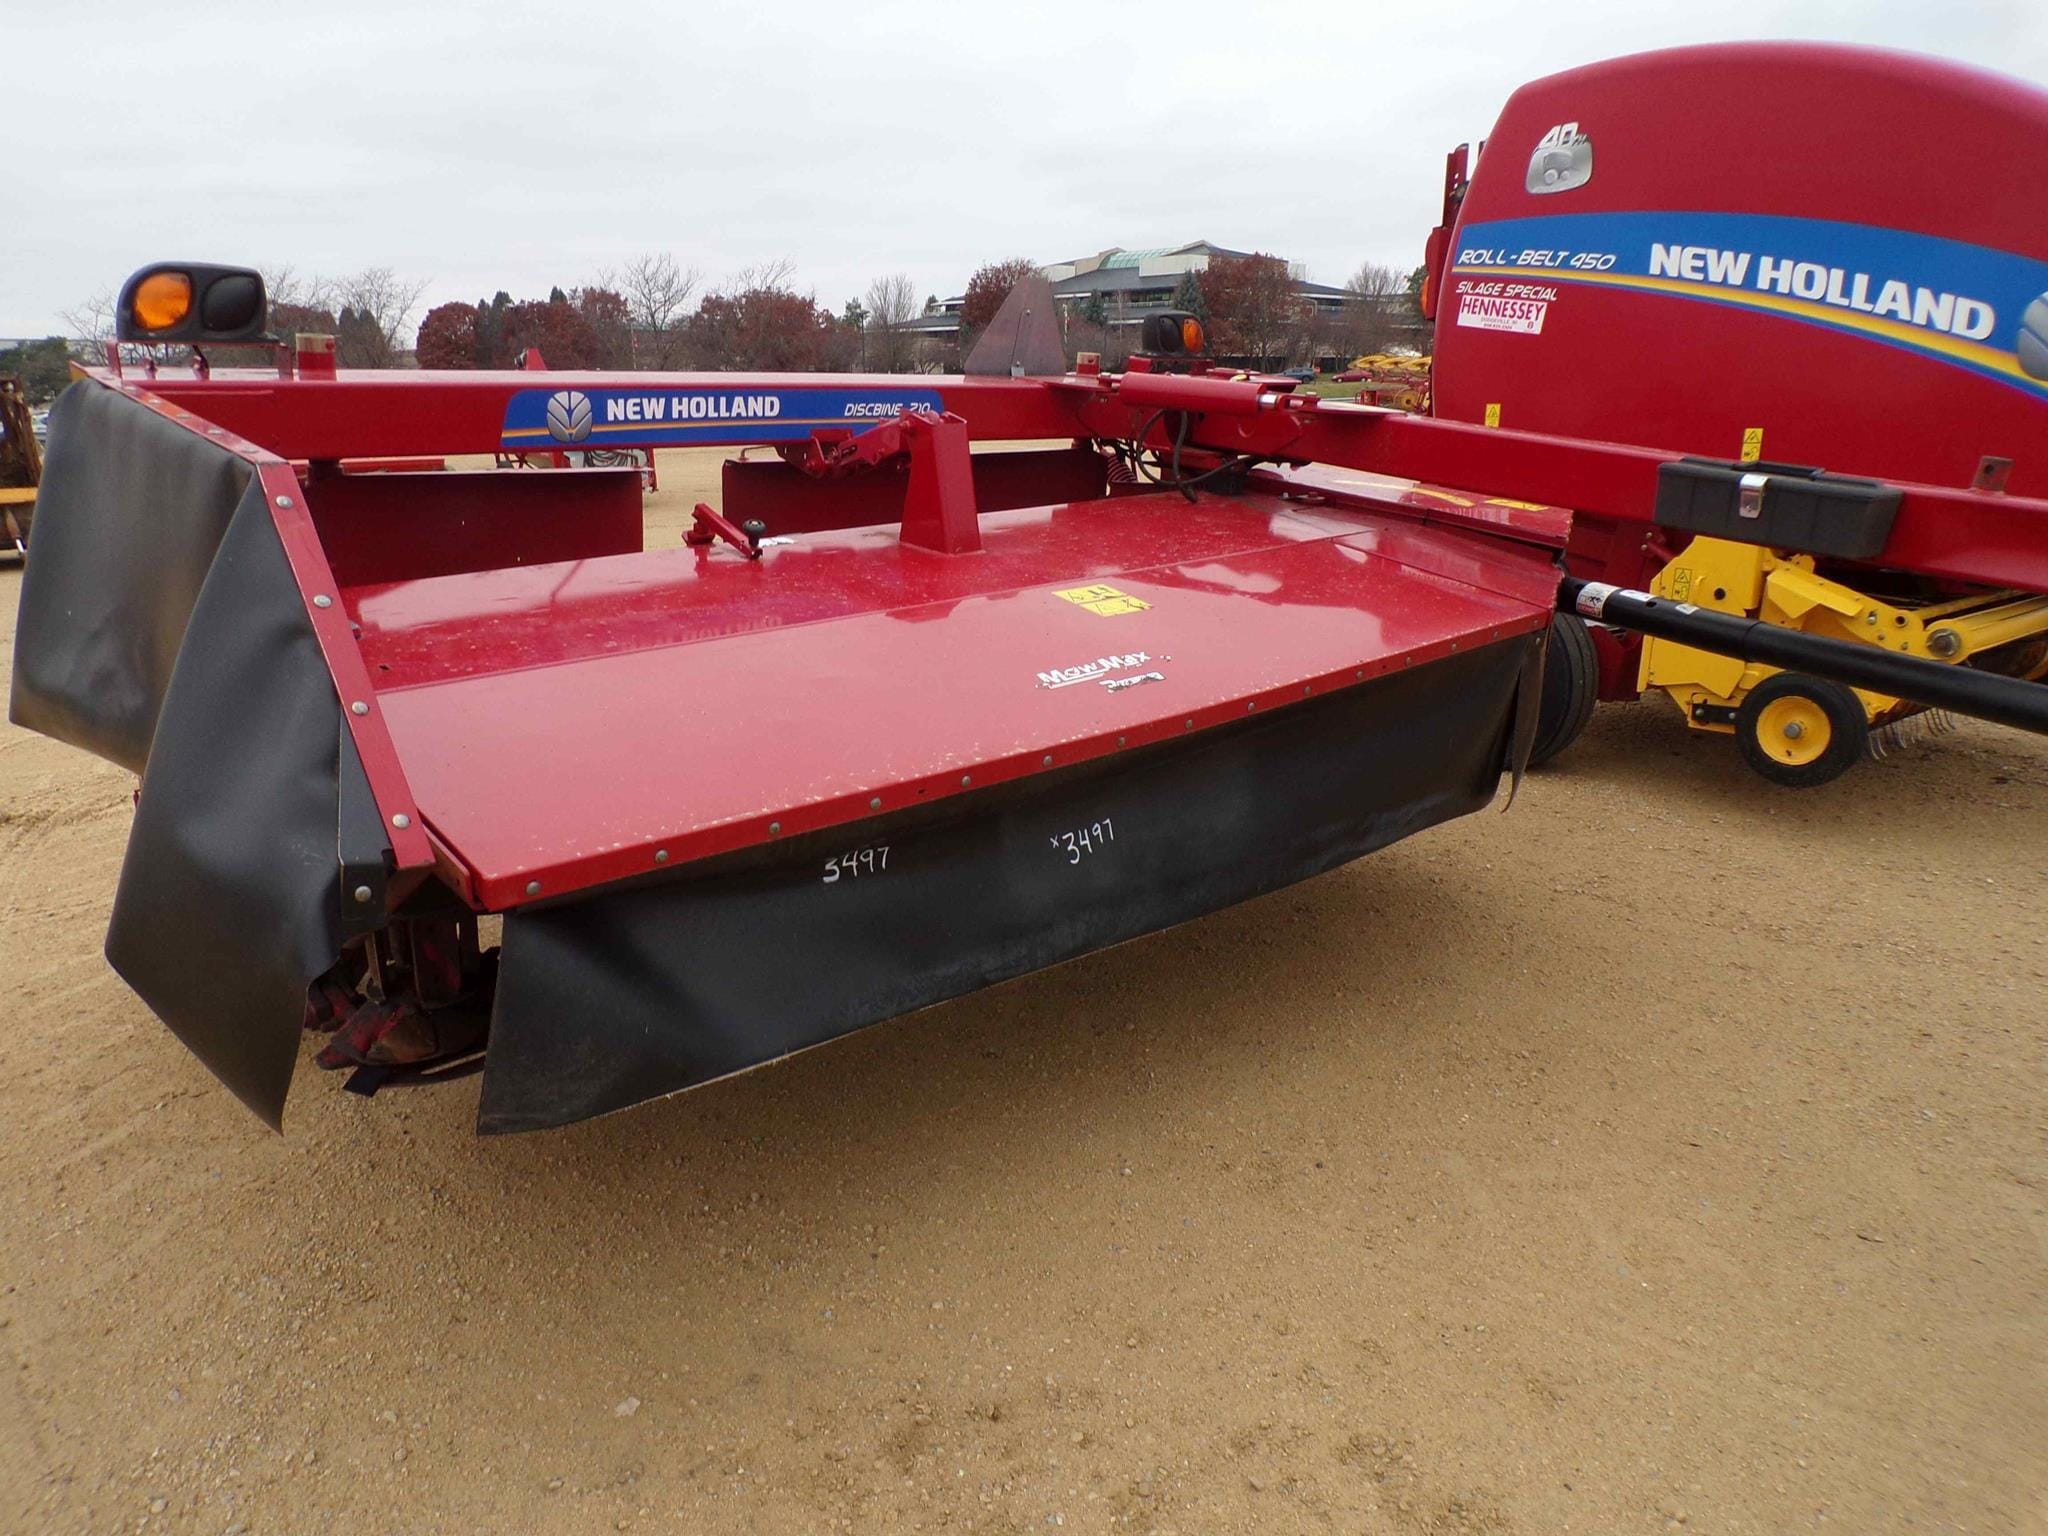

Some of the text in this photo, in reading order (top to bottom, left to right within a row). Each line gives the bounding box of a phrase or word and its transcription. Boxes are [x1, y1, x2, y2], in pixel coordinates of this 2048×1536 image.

[1569, 252, 1617, 270] 450
[1456, 280, 1558, 301] SILAGE SPECIAL
[1648, 243, 1996, 341] NEW HOLLAND
[1461, 297, 1545, 322] HENNESSEY
[606, 396, 781, 422] NEW HOLLAND
[843, 402, 904, 417] DISCBINE
